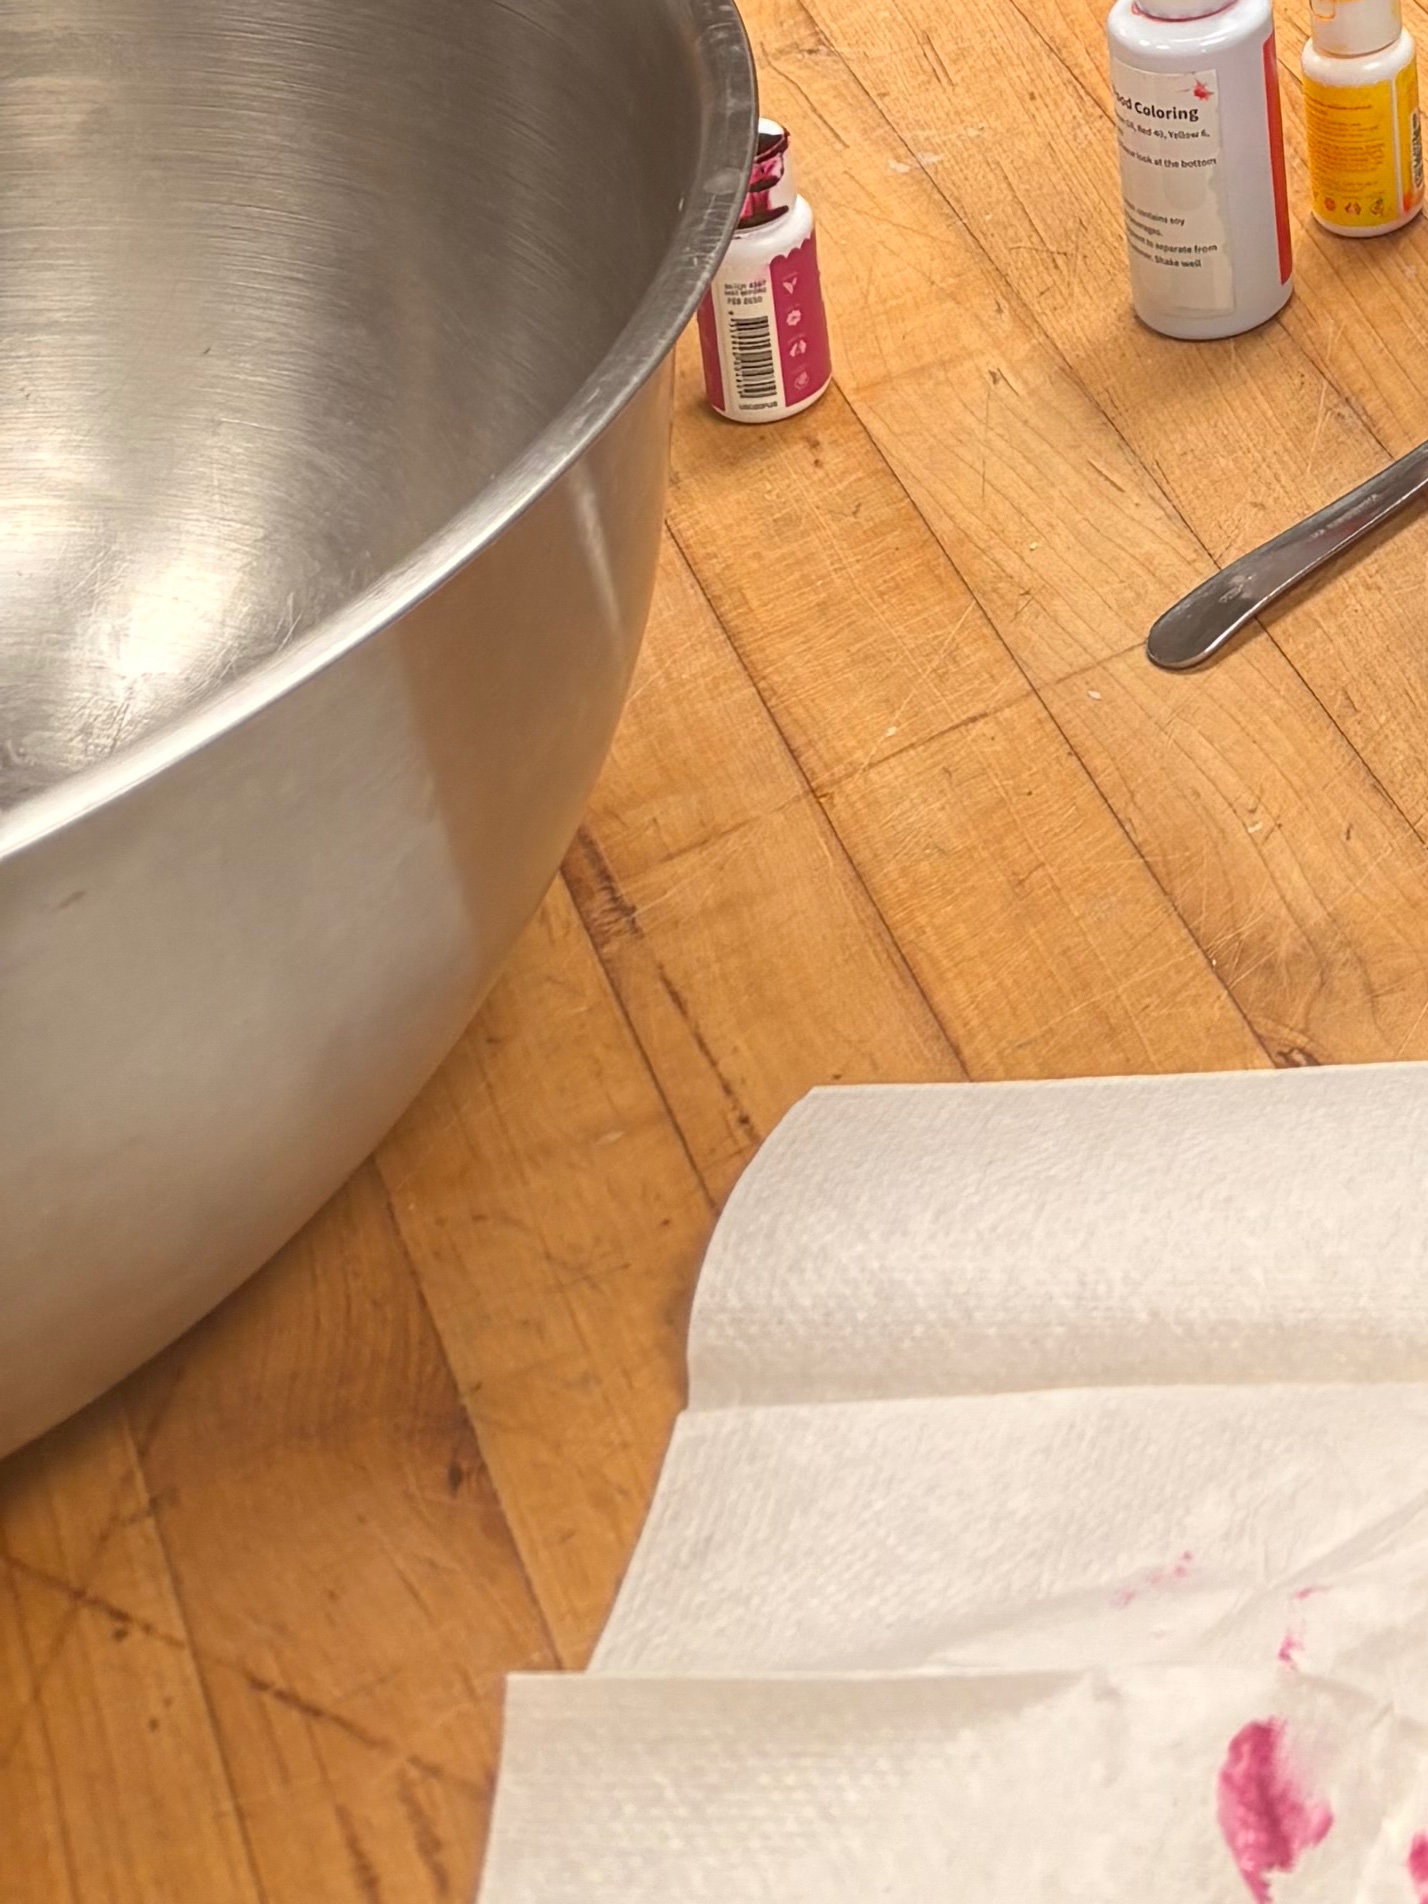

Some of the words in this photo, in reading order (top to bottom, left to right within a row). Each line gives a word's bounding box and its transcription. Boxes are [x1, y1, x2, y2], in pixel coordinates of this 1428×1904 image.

[1134, 101, 1200, 123] Coloring
[1163, 159, 1180, 169] the
[1181, 157, 1217, 169] bottom
[1193, 244, 1218, 254] from
[1181, 259, 1202, 268] well
